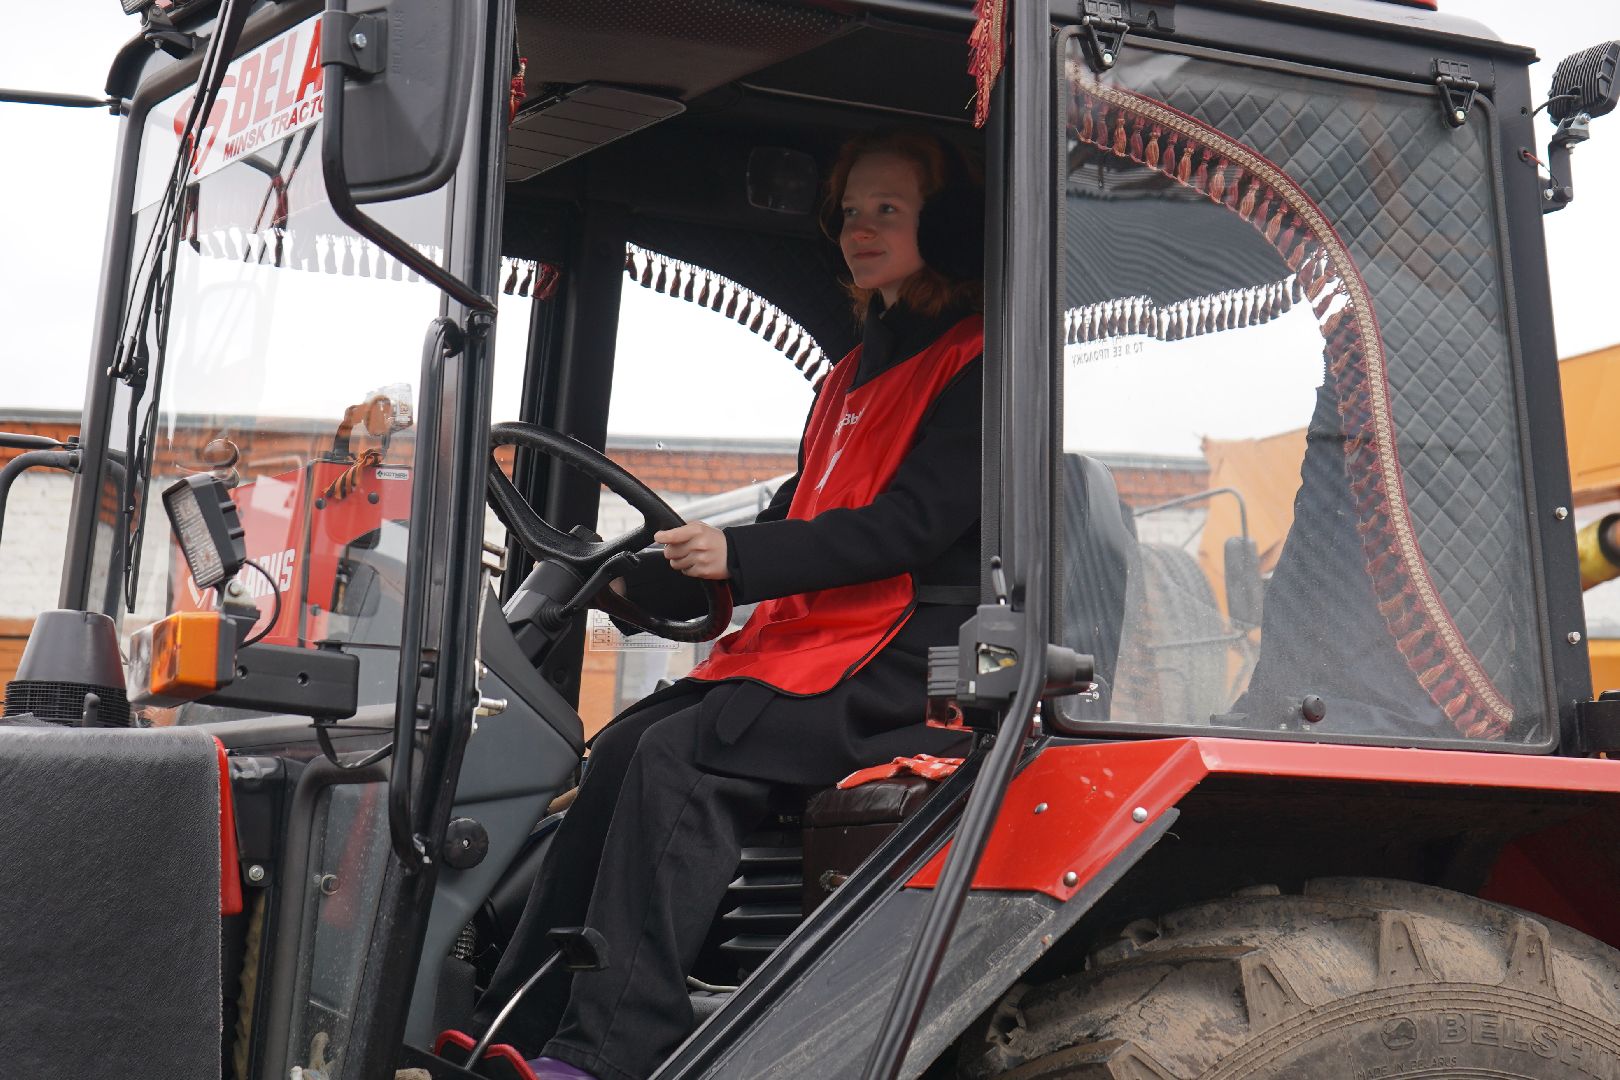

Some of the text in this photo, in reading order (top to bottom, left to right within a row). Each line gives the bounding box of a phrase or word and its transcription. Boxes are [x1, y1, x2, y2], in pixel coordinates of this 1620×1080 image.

[228, 18, 323, 137] BELA
[224, 125, 265, 161] MINSK
[1411, 1056, 1457, 1071] BELARUS
